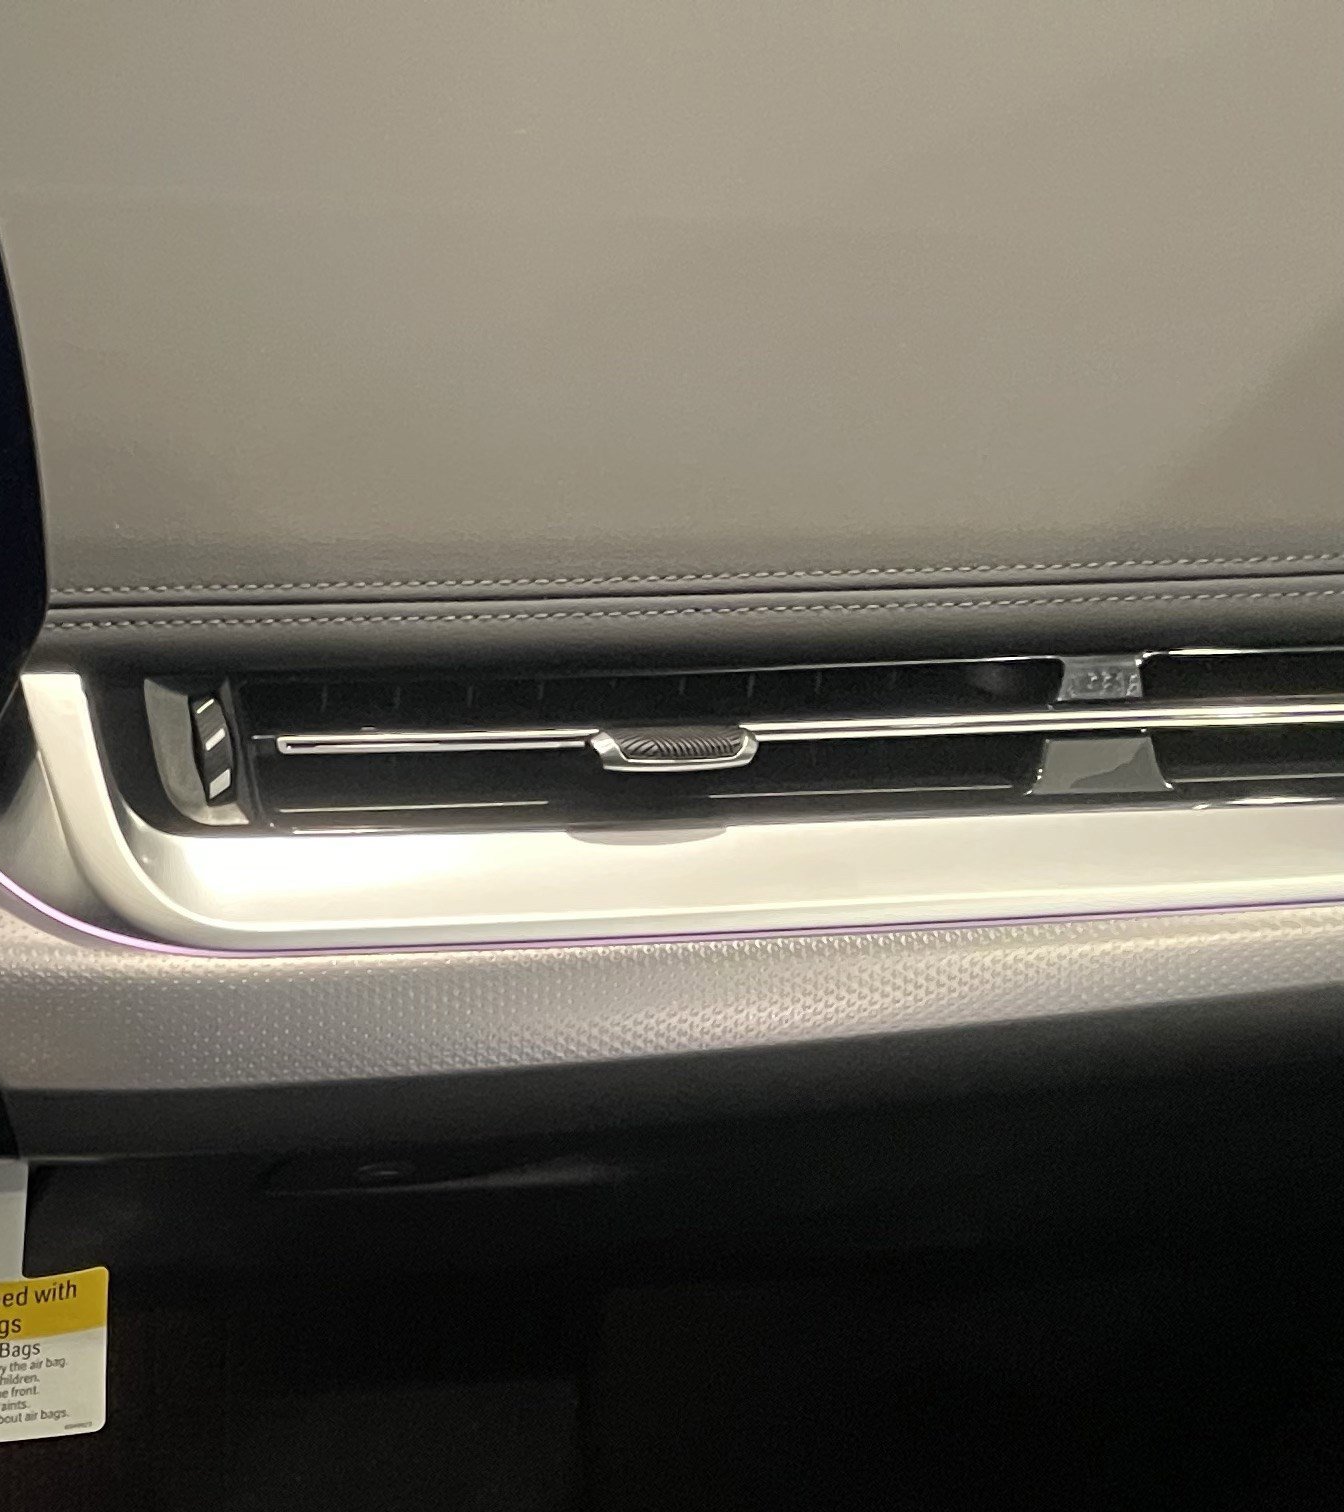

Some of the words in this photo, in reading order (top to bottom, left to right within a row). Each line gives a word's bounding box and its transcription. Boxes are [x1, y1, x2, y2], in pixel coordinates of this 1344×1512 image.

[34, 1280, 77, 1304] with
[0, 1342, 41, 1360] Bags
[9, 1361, 27, 1372] the
[30, 1359, 44, 1370] air
